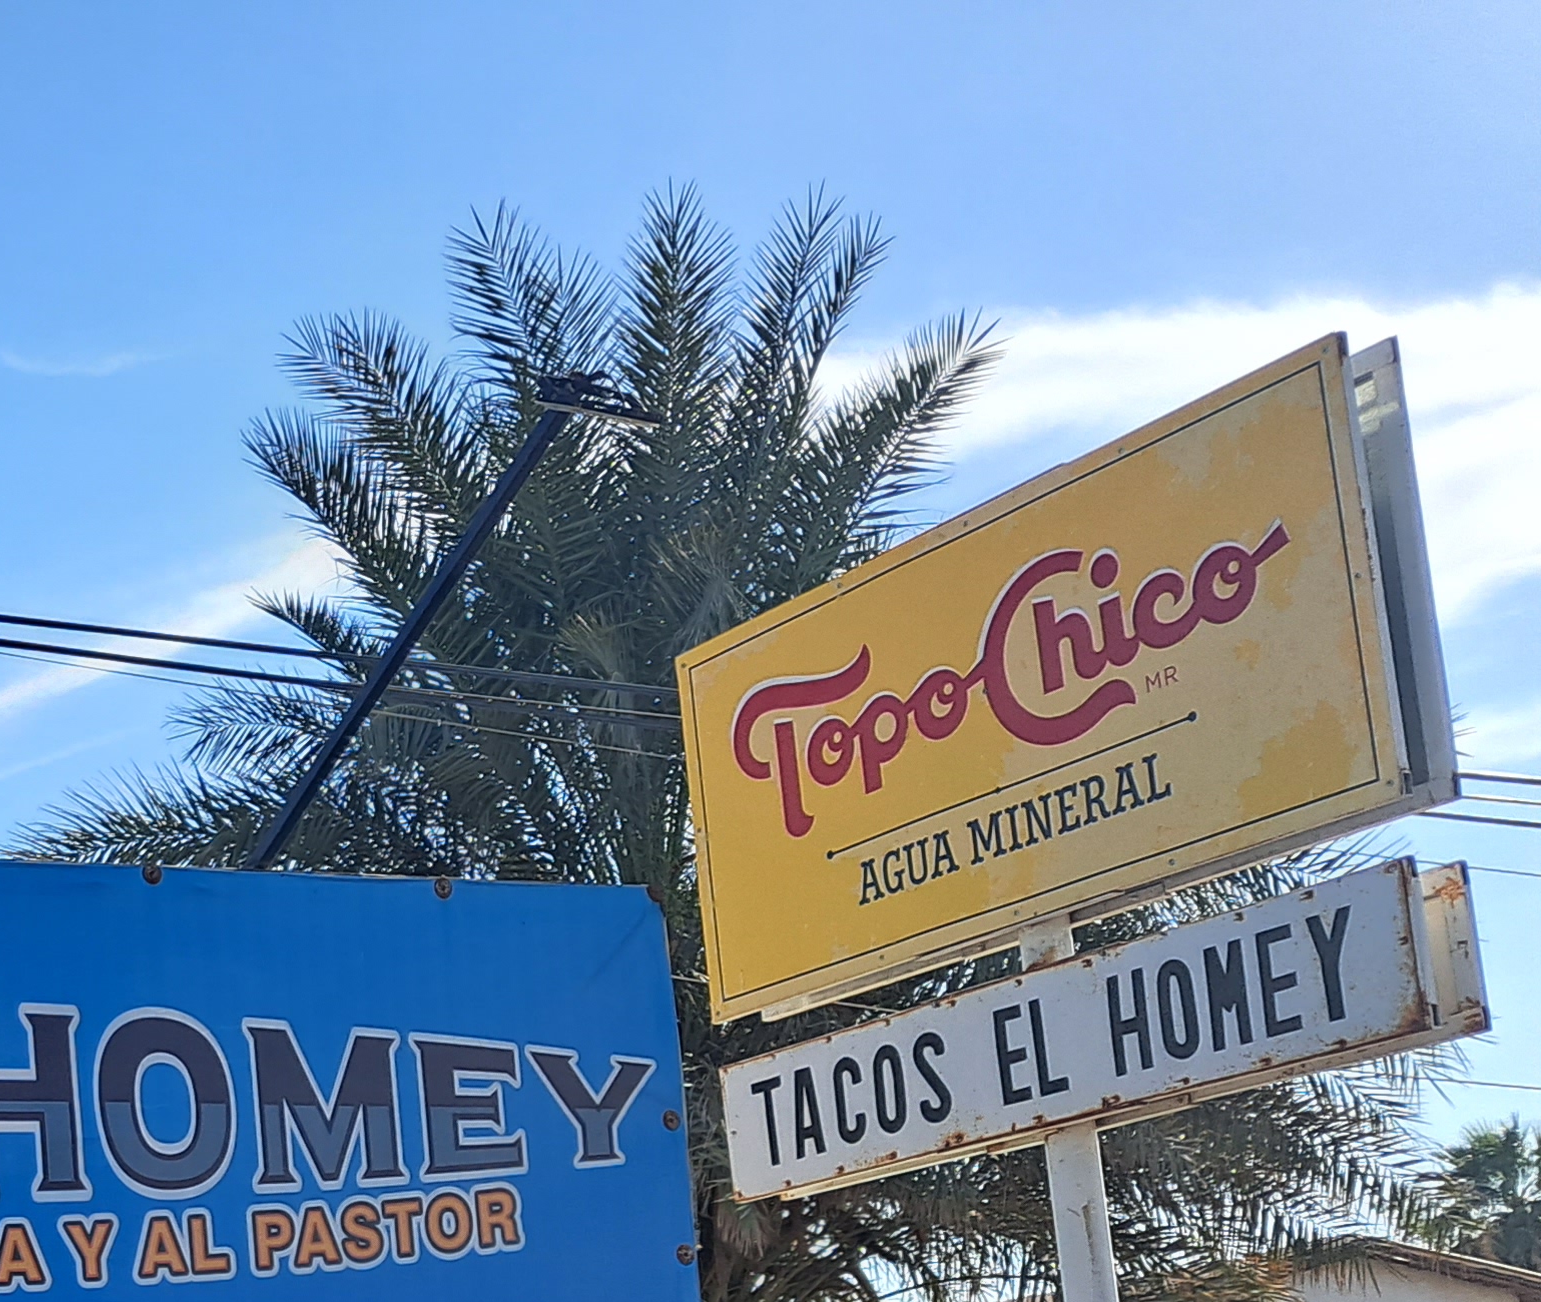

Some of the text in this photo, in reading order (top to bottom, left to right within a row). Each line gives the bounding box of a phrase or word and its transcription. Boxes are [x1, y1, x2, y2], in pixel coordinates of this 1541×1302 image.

[732, 519, 1291, 838] Topo Chico
[1144, 665, 1179, 693] MR
[858, 753, 1172, 906] AGUA MINERAL
[750, 905, 1354, 1167] TACOS EL HOMEY
[59, 1213, 119, 1289] Y
[133, 1207, 234, 1284] AL
[247, 1182, 525, 1276] PASTOR
